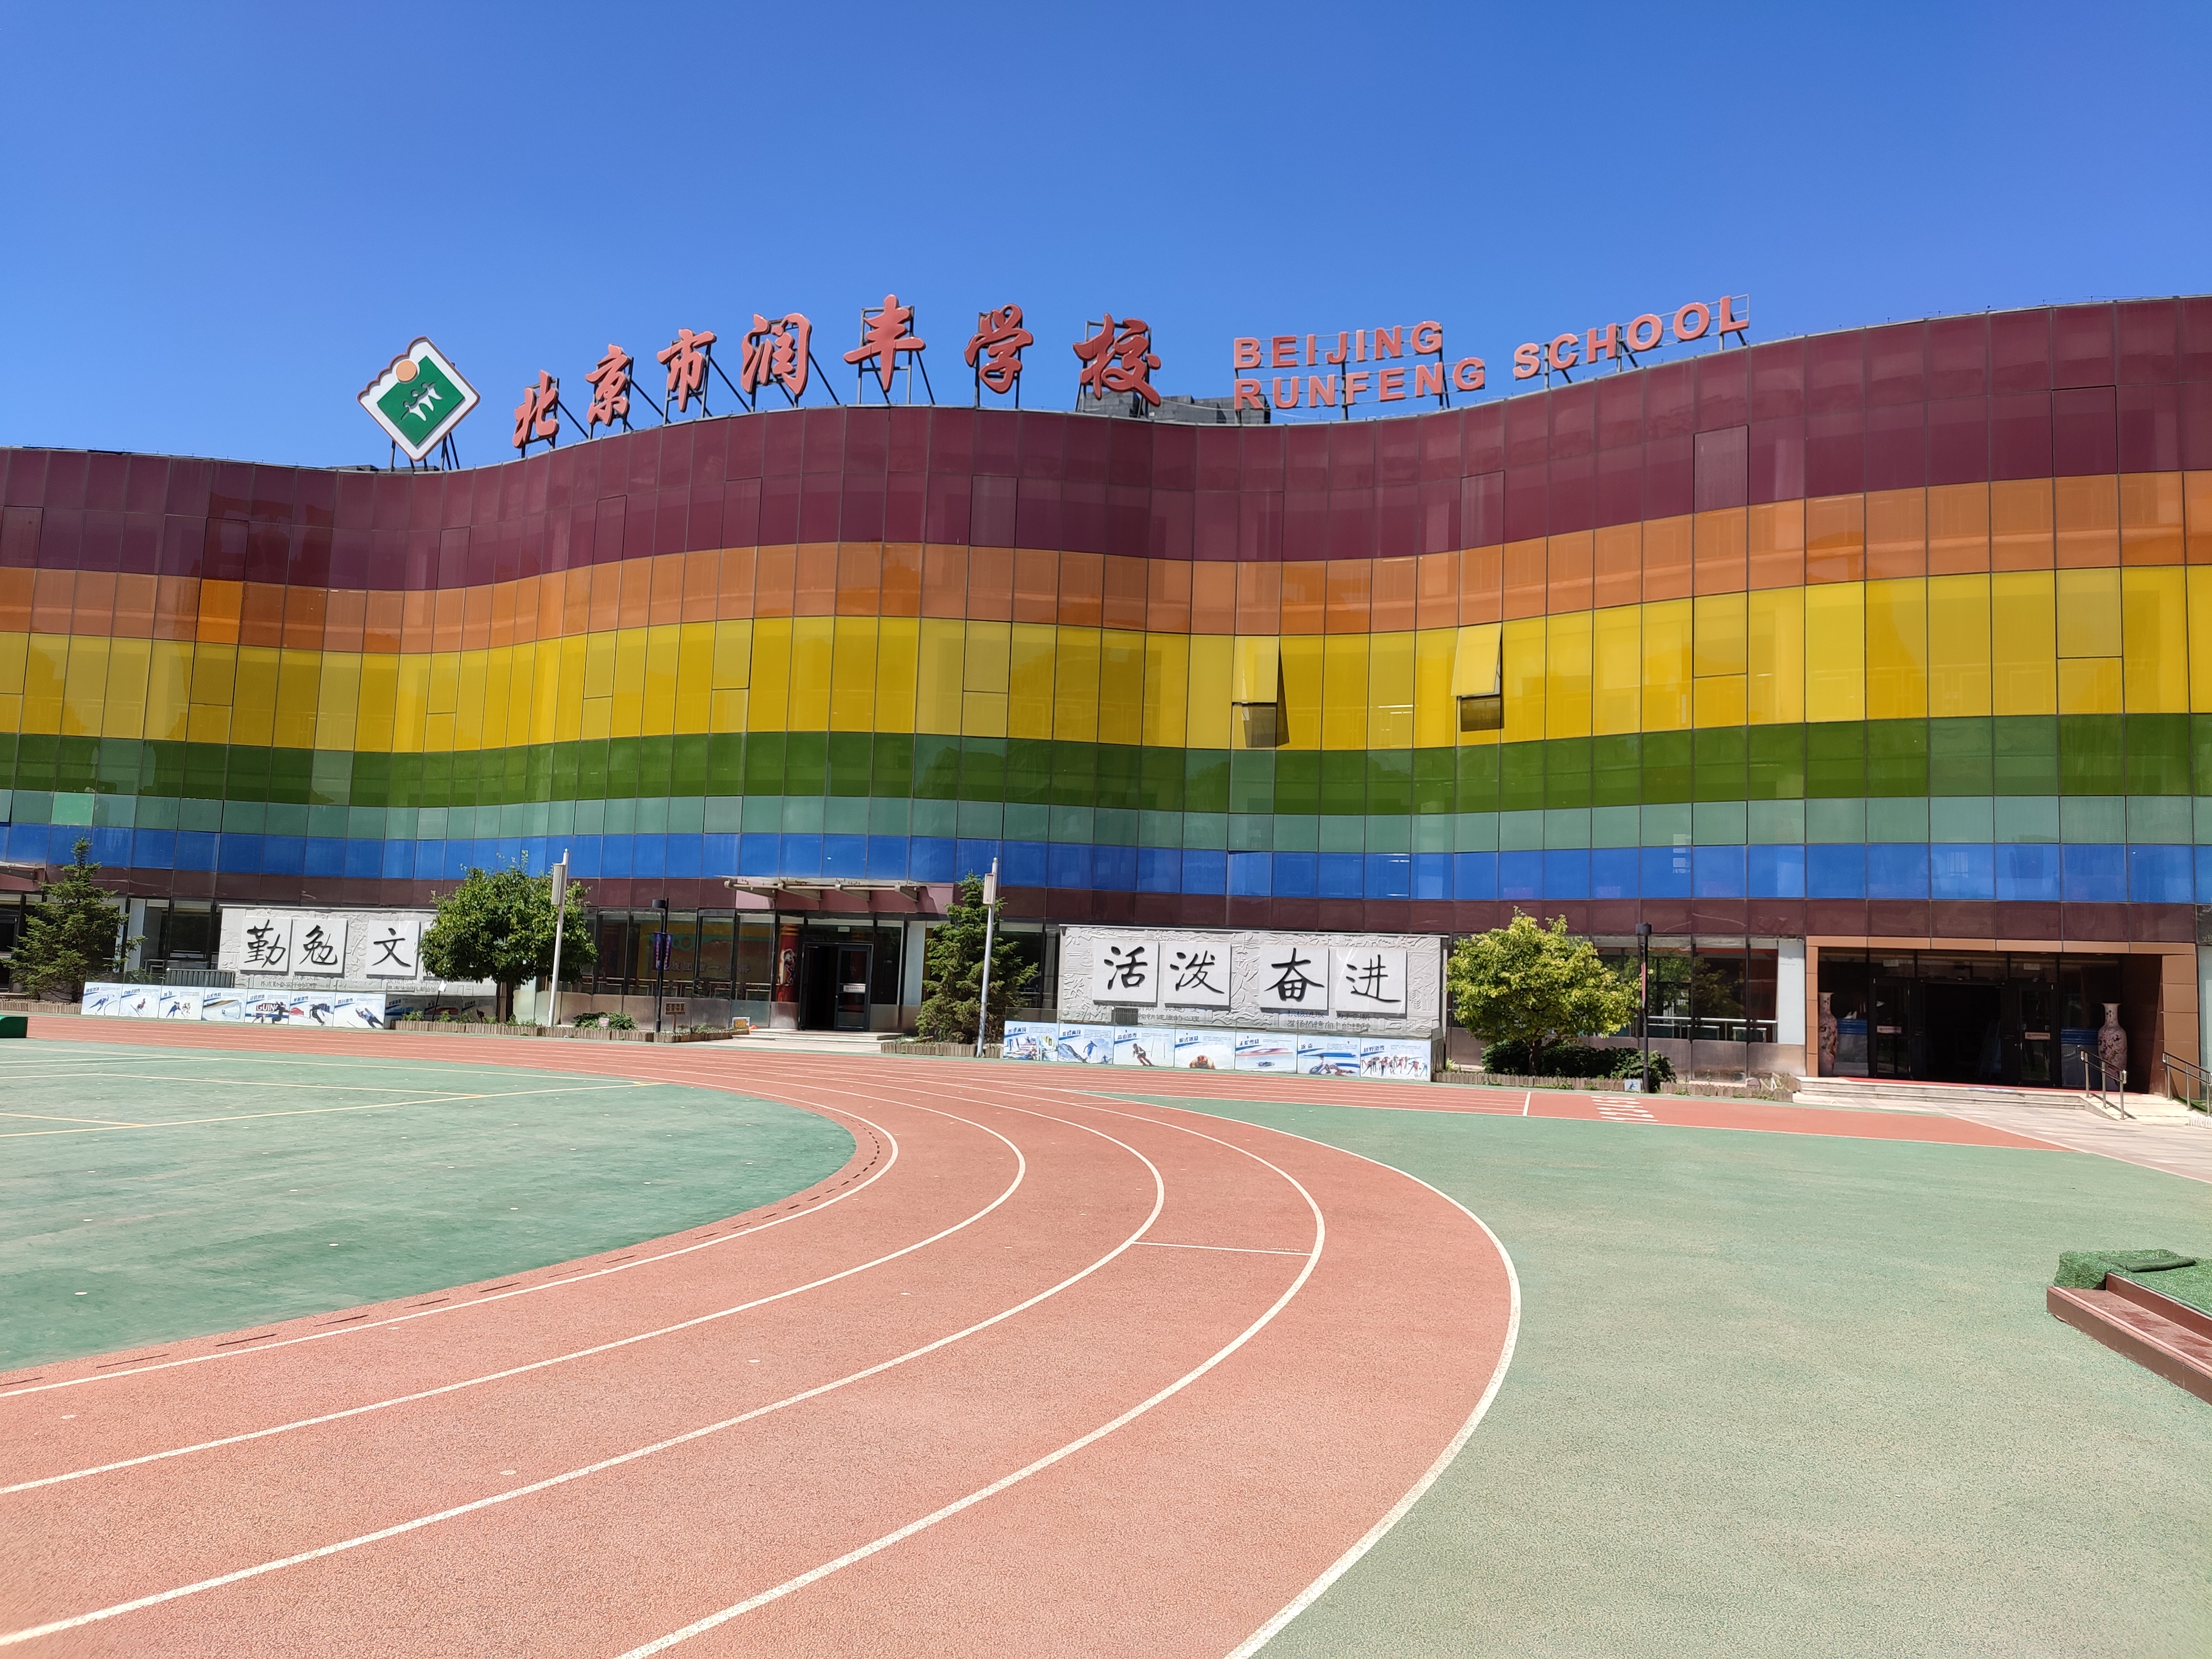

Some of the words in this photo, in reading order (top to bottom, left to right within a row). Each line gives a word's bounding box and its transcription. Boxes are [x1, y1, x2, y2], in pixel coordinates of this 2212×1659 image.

[513, 293, 1161, 448] 北京市润丰学校
[1234, 320, 1442, 369] BEIJING
[1234, 357, 1485, 410] RUNFENG
[1513, 295, 1749, 379] SCHOOL
